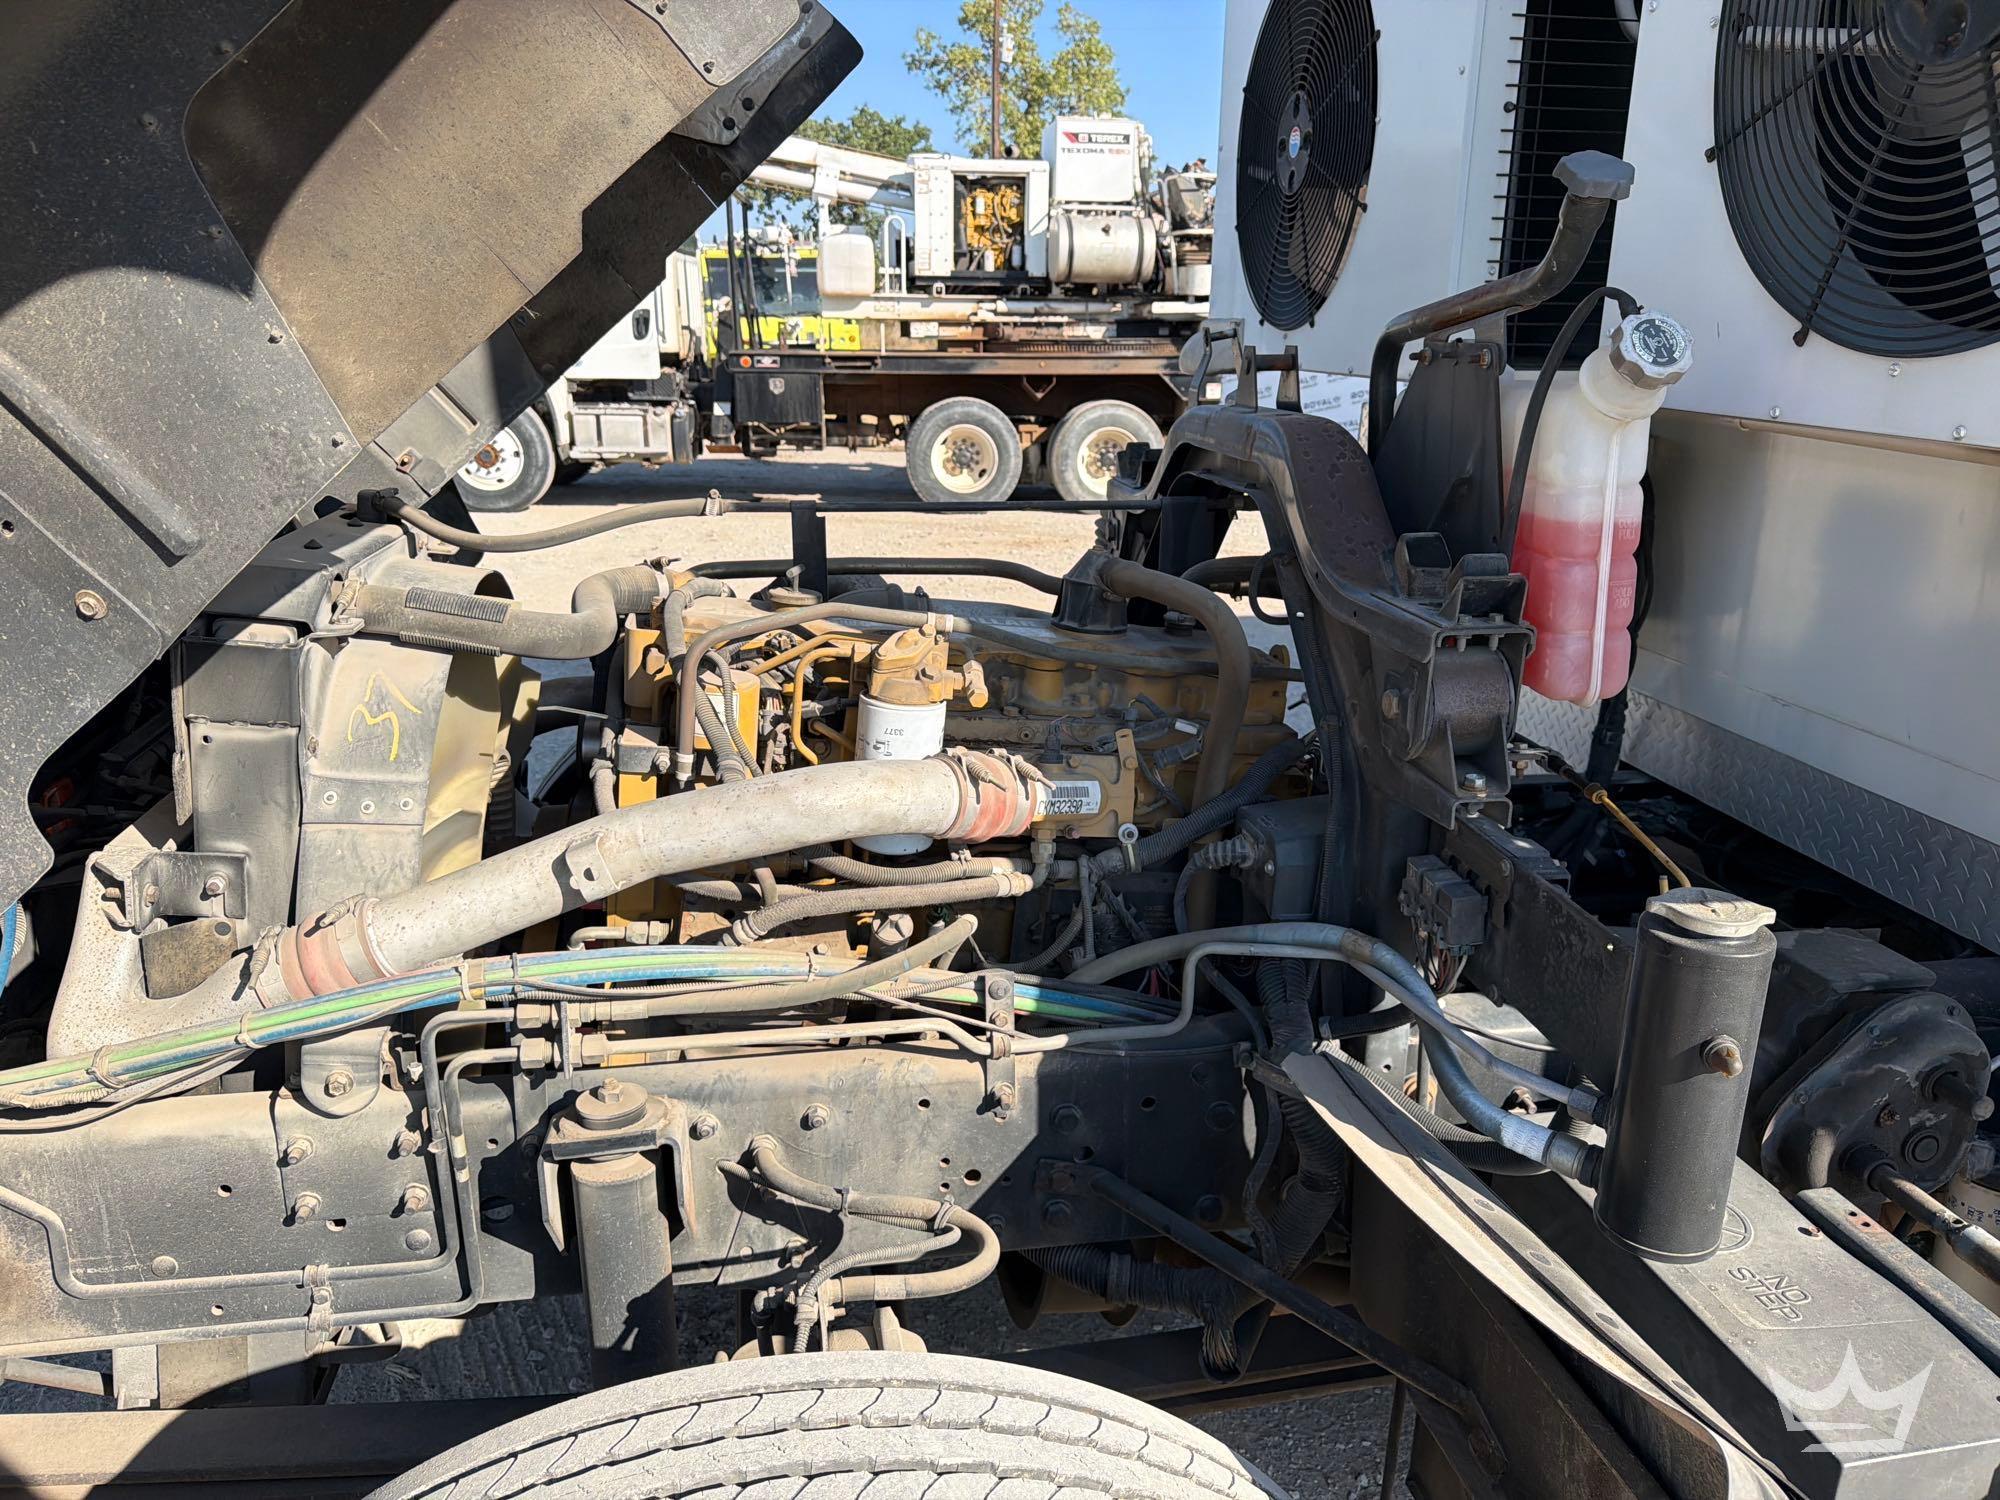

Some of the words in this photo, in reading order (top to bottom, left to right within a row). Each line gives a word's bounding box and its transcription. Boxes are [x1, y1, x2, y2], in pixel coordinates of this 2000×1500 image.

[1090, 134, 1124, 143] TEREX
[883, 727, 905, 736] 3377
[1037, 799, 1083, 815] CKM32390
[1727, 1266, 1803, 1321] STEP
[1764, 1273, 1811, 1304] NO
